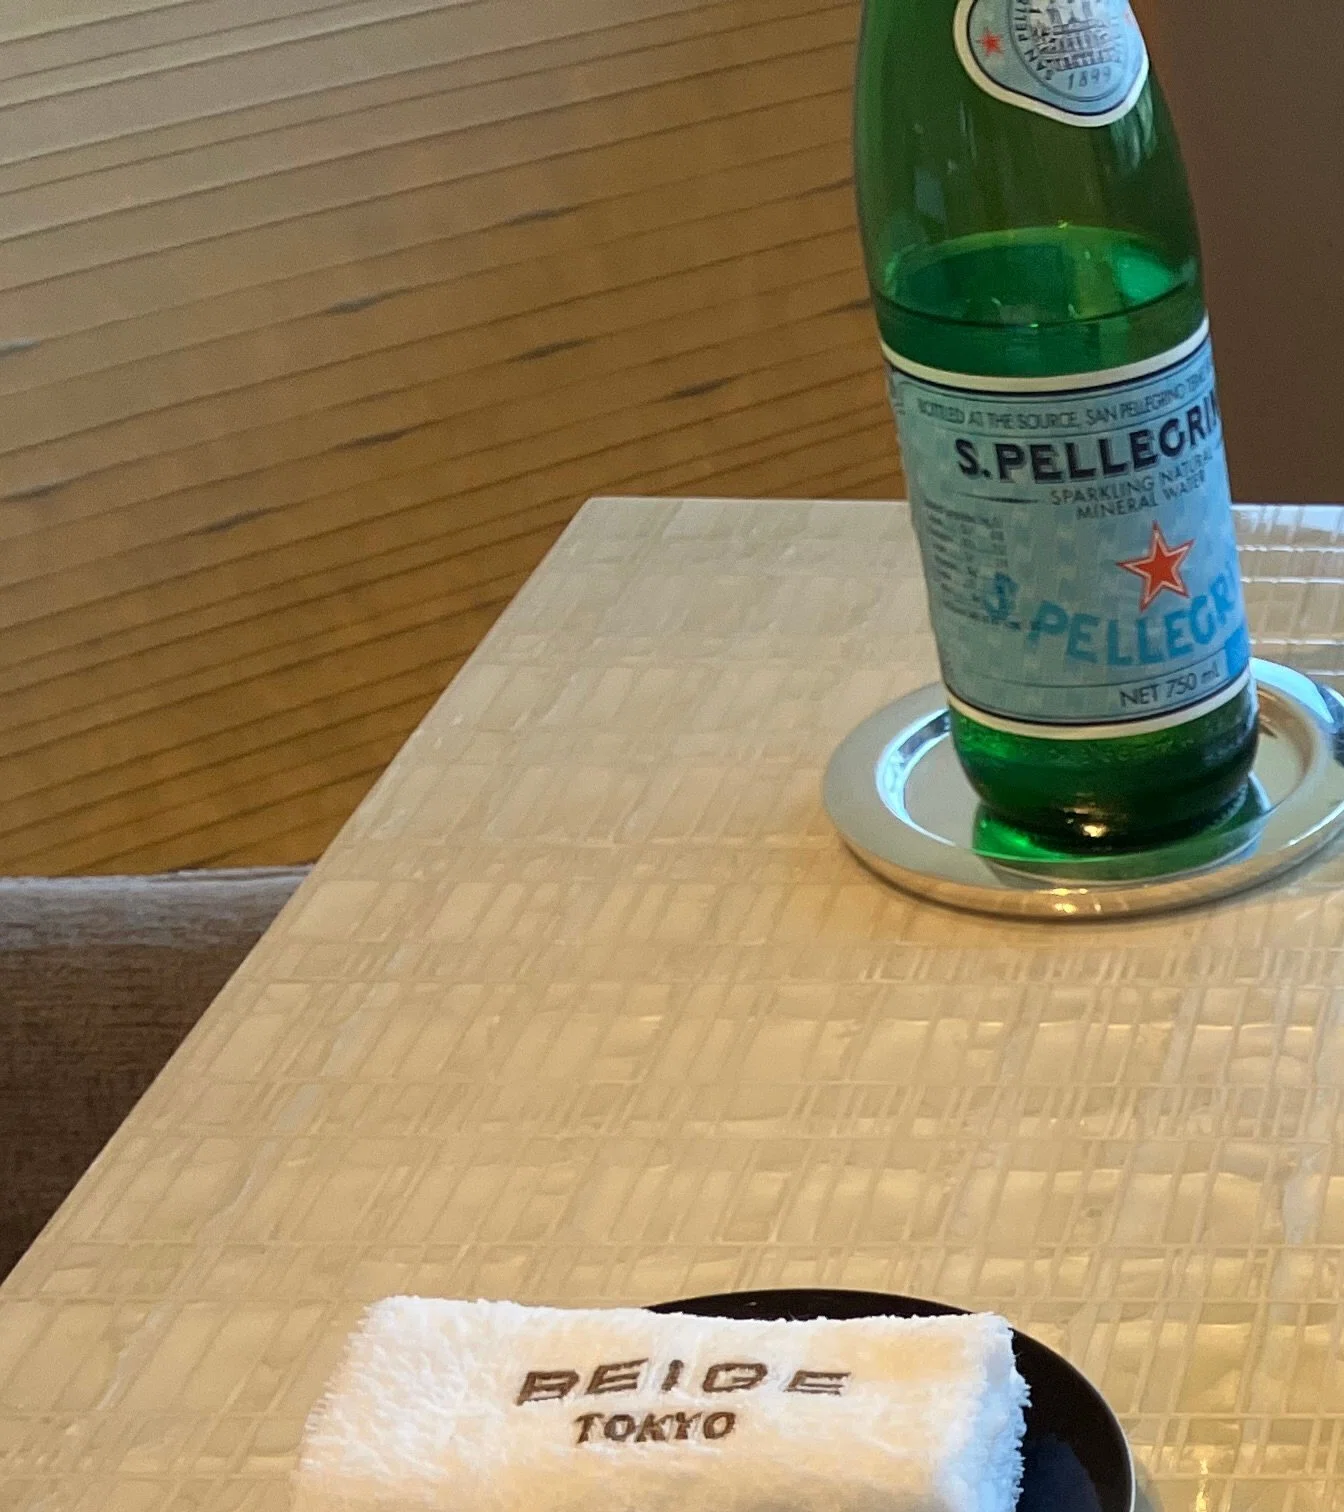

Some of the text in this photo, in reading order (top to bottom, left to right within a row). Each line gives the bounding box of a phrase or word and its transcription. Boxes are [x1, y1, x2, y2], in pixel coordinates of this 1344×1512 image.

[968, 411, 985, 428] AT
[1086, 406, 1117, 427] SAN
[1050, 475, 1155, 506] SPARKLING
[1075, 497, 1159, 521] MINERAL
[1119, 684, 1161, 708] NET
[1164, 671, 1198, 698] 750
[575, 1410, 737, 1444] TOKYO
